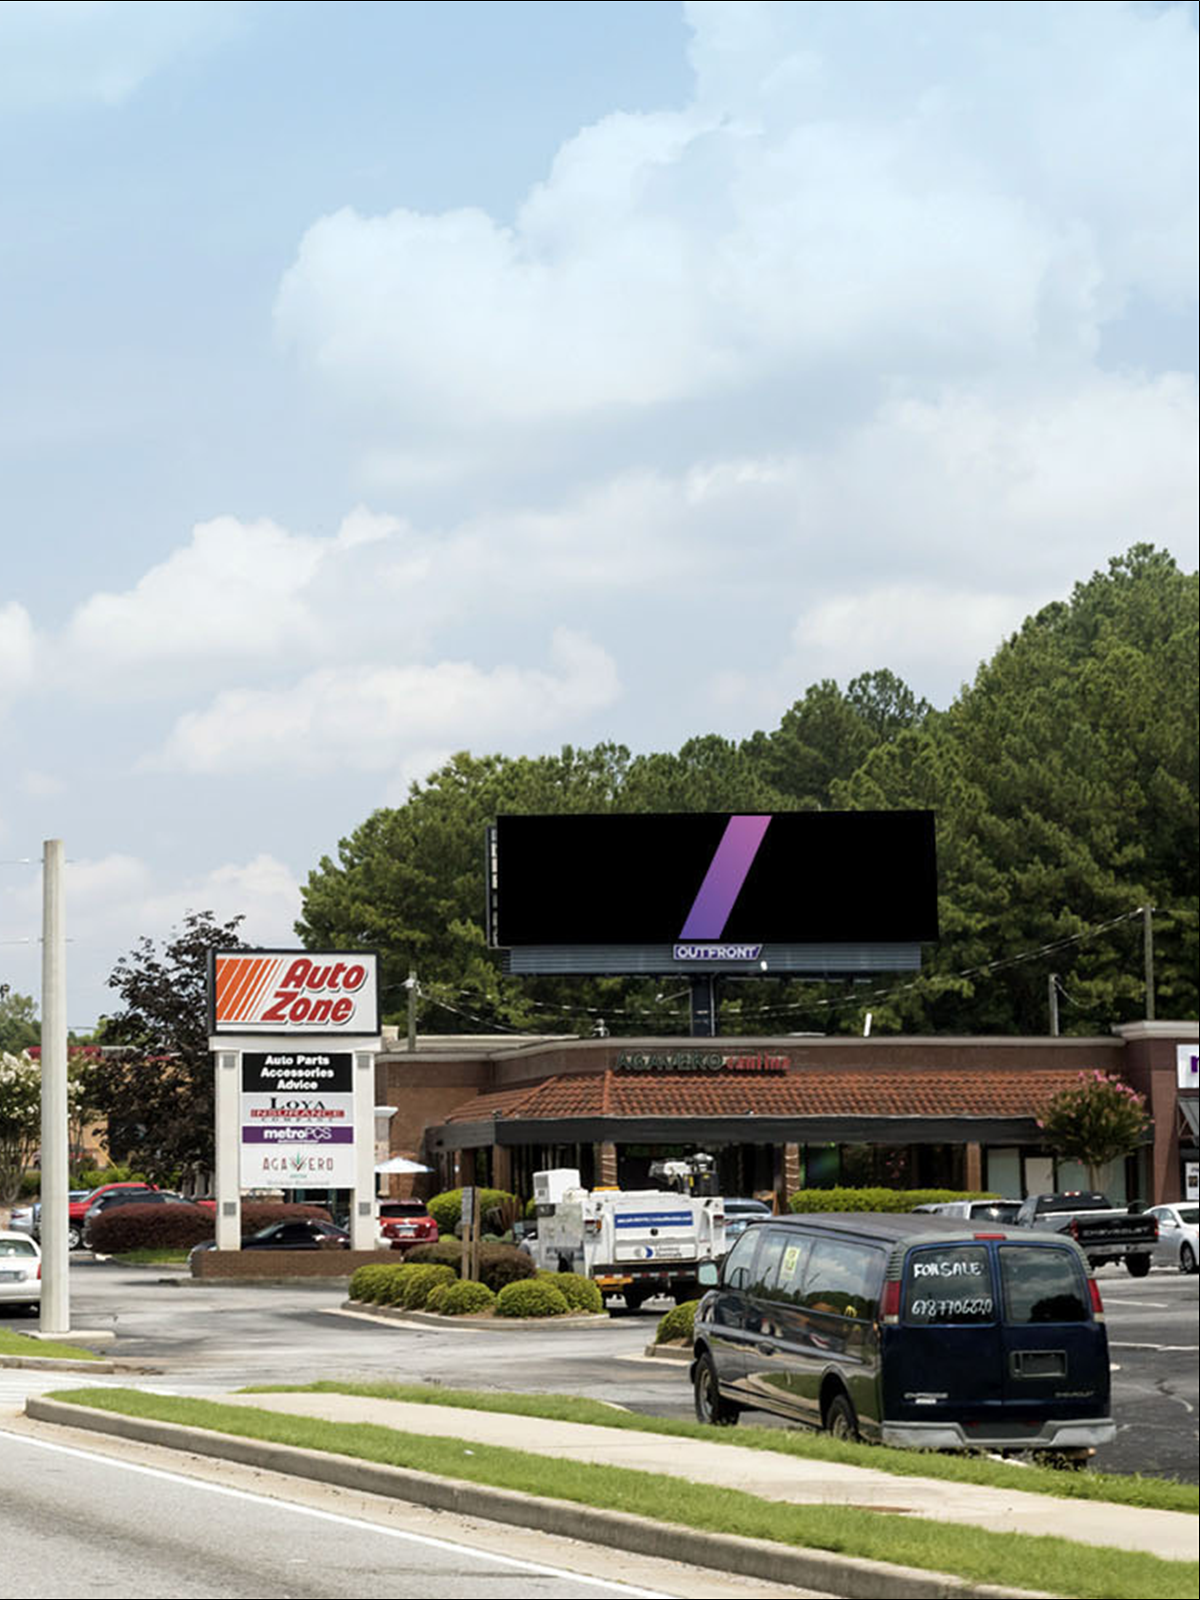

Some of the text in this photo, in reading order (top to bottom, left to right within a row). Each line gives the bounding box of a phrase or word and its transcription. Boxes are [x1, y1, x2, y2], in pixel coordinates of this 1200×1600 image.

[677, 946, 756, 958] OUTFRONT
[279, 958, 368, 993] Auto
[260, 991, 356, 1025] Zone
[265, 1055, 331, 1066] Auto Parts
[616, 1052, 723, 1071] AGAVERO
[260, 1067, 335, 1079] Accessories
[277, 1079, 319, 1090] Advice
[270, 1097, 326, 1110] LOYA
[250, 1109, 345, 1118] INSURANCE
[263, 1127, 332, 1140] metroPCS
[940, 1262, 981, 1277] SALE
